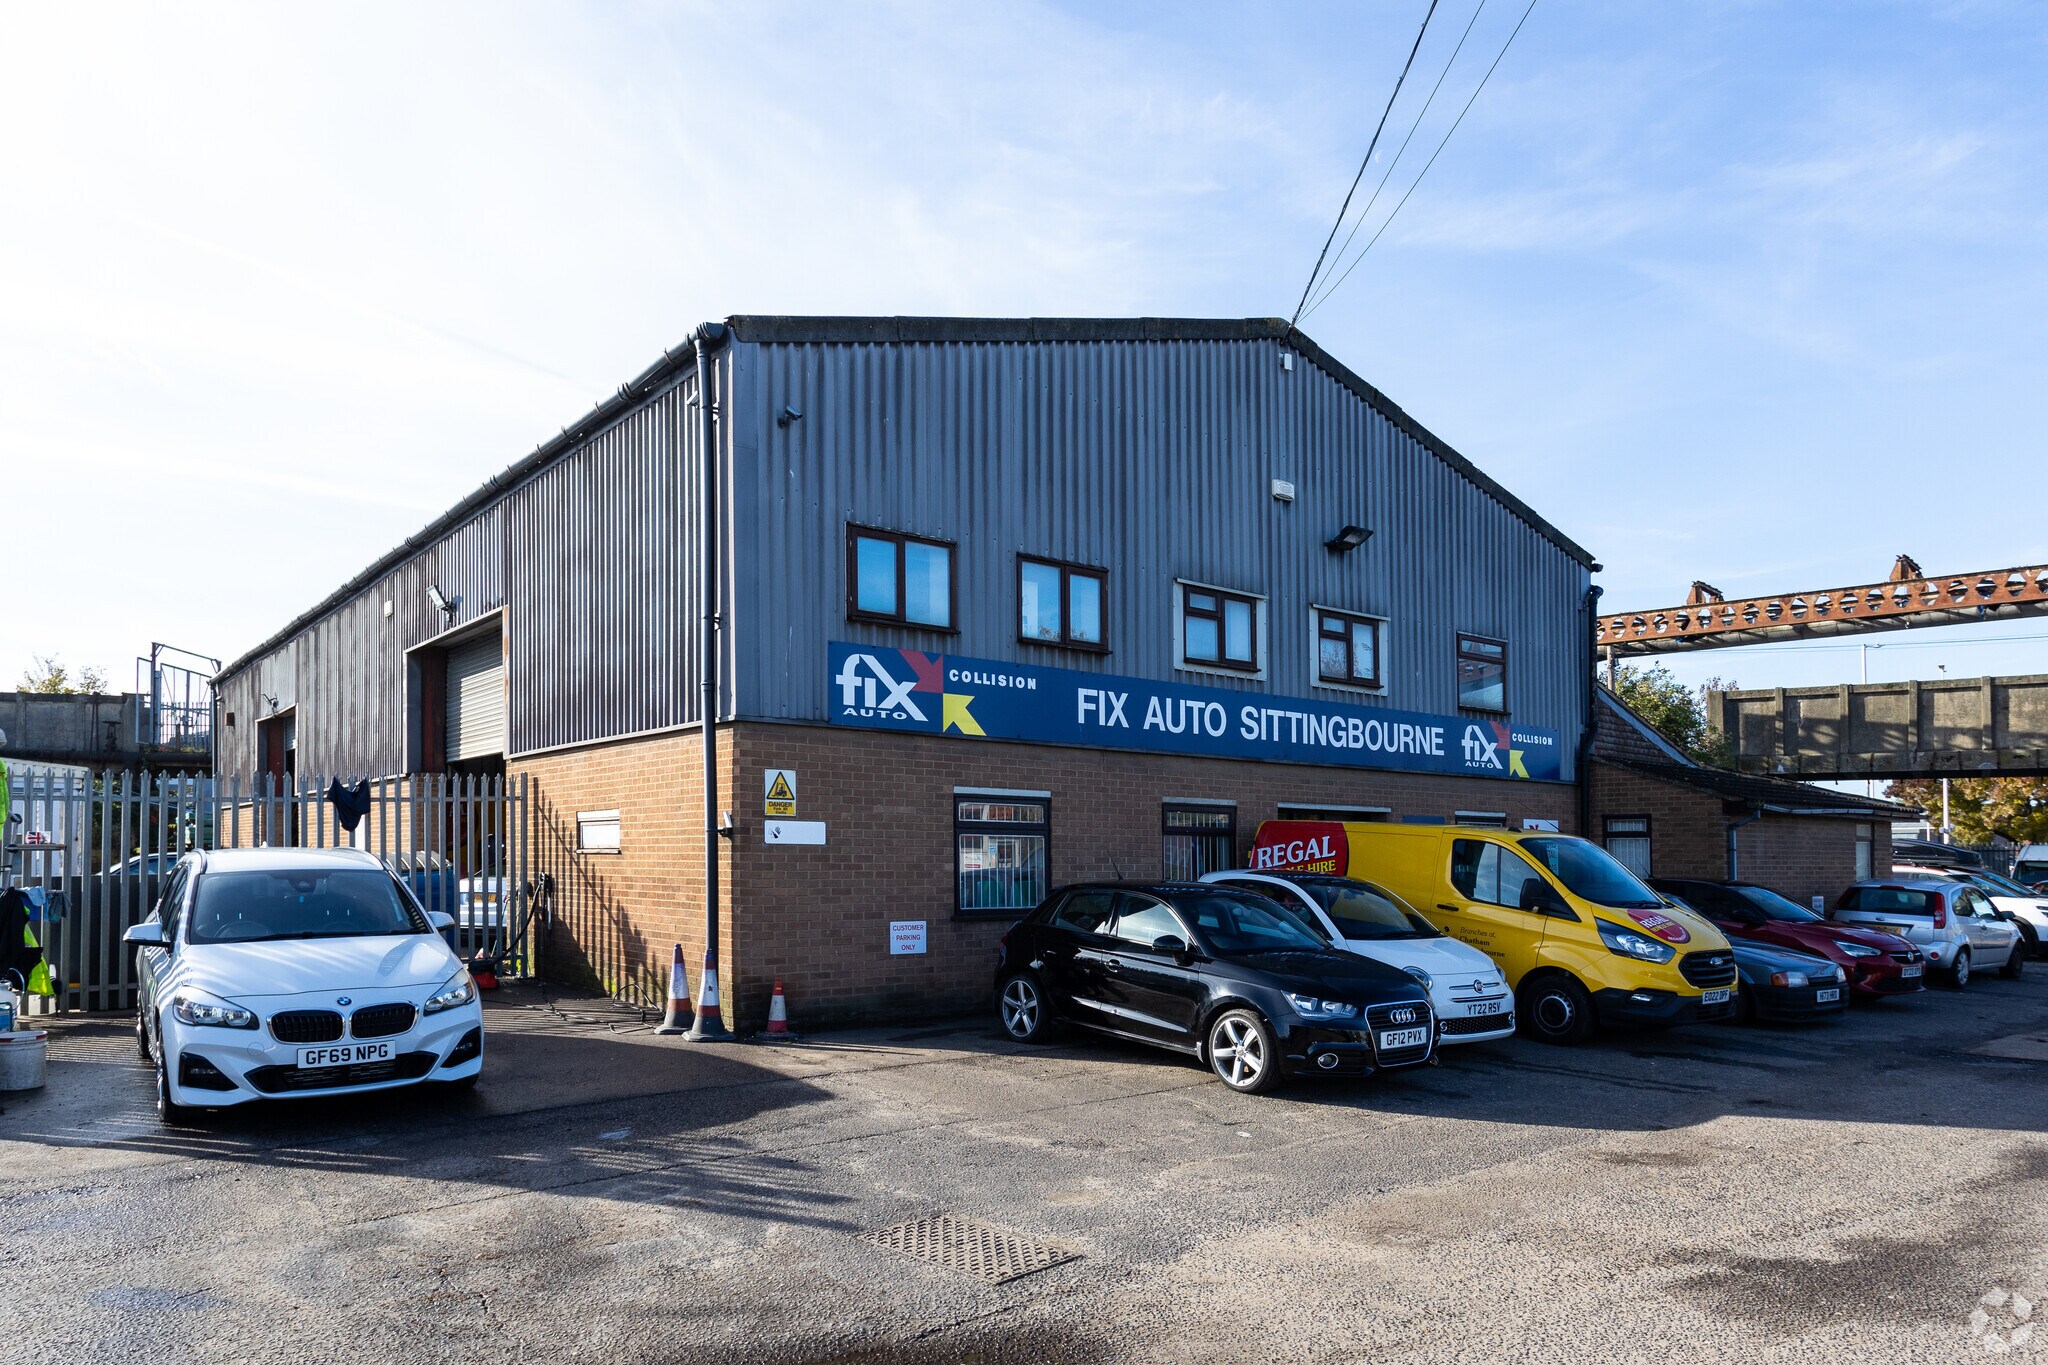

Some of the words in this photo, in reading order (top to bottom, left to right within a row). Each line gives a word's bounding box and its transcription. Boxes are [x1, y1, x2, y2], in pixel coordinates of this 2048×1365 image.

[949, 669, 1037, 690] COLLISION
[843, 707, 907, 720] AUTO
[1077, 687, 1129, 728] FIX
[1143, 696, 1227, 737] AUTO
[1240, 705, 1445, 756] SITTINGBOURNE
[1512, 732, 1553, 746] COLLISION
[1465, 760, 1494, 769] AUTO
[1257, 835, 1336, 869] REGAL
[1307, 860, 1337, 872] HIRE
[892, 924, 924, 932] CUSTOMER
[1460, 926, 1488, 937] Branches
[1459, 935, 1490, 946] Chatham
[1467, 1003, 1487, 1015] YT22
[1487, 1002, 1501, 1013] RSV
[1386, 1032, 1406, 1046] GF12
[1407, 1030, 1422, 1043] PVX
[305, 1048, 351, 1065] GF69
[356, 1044, 388, 1060] NPG
